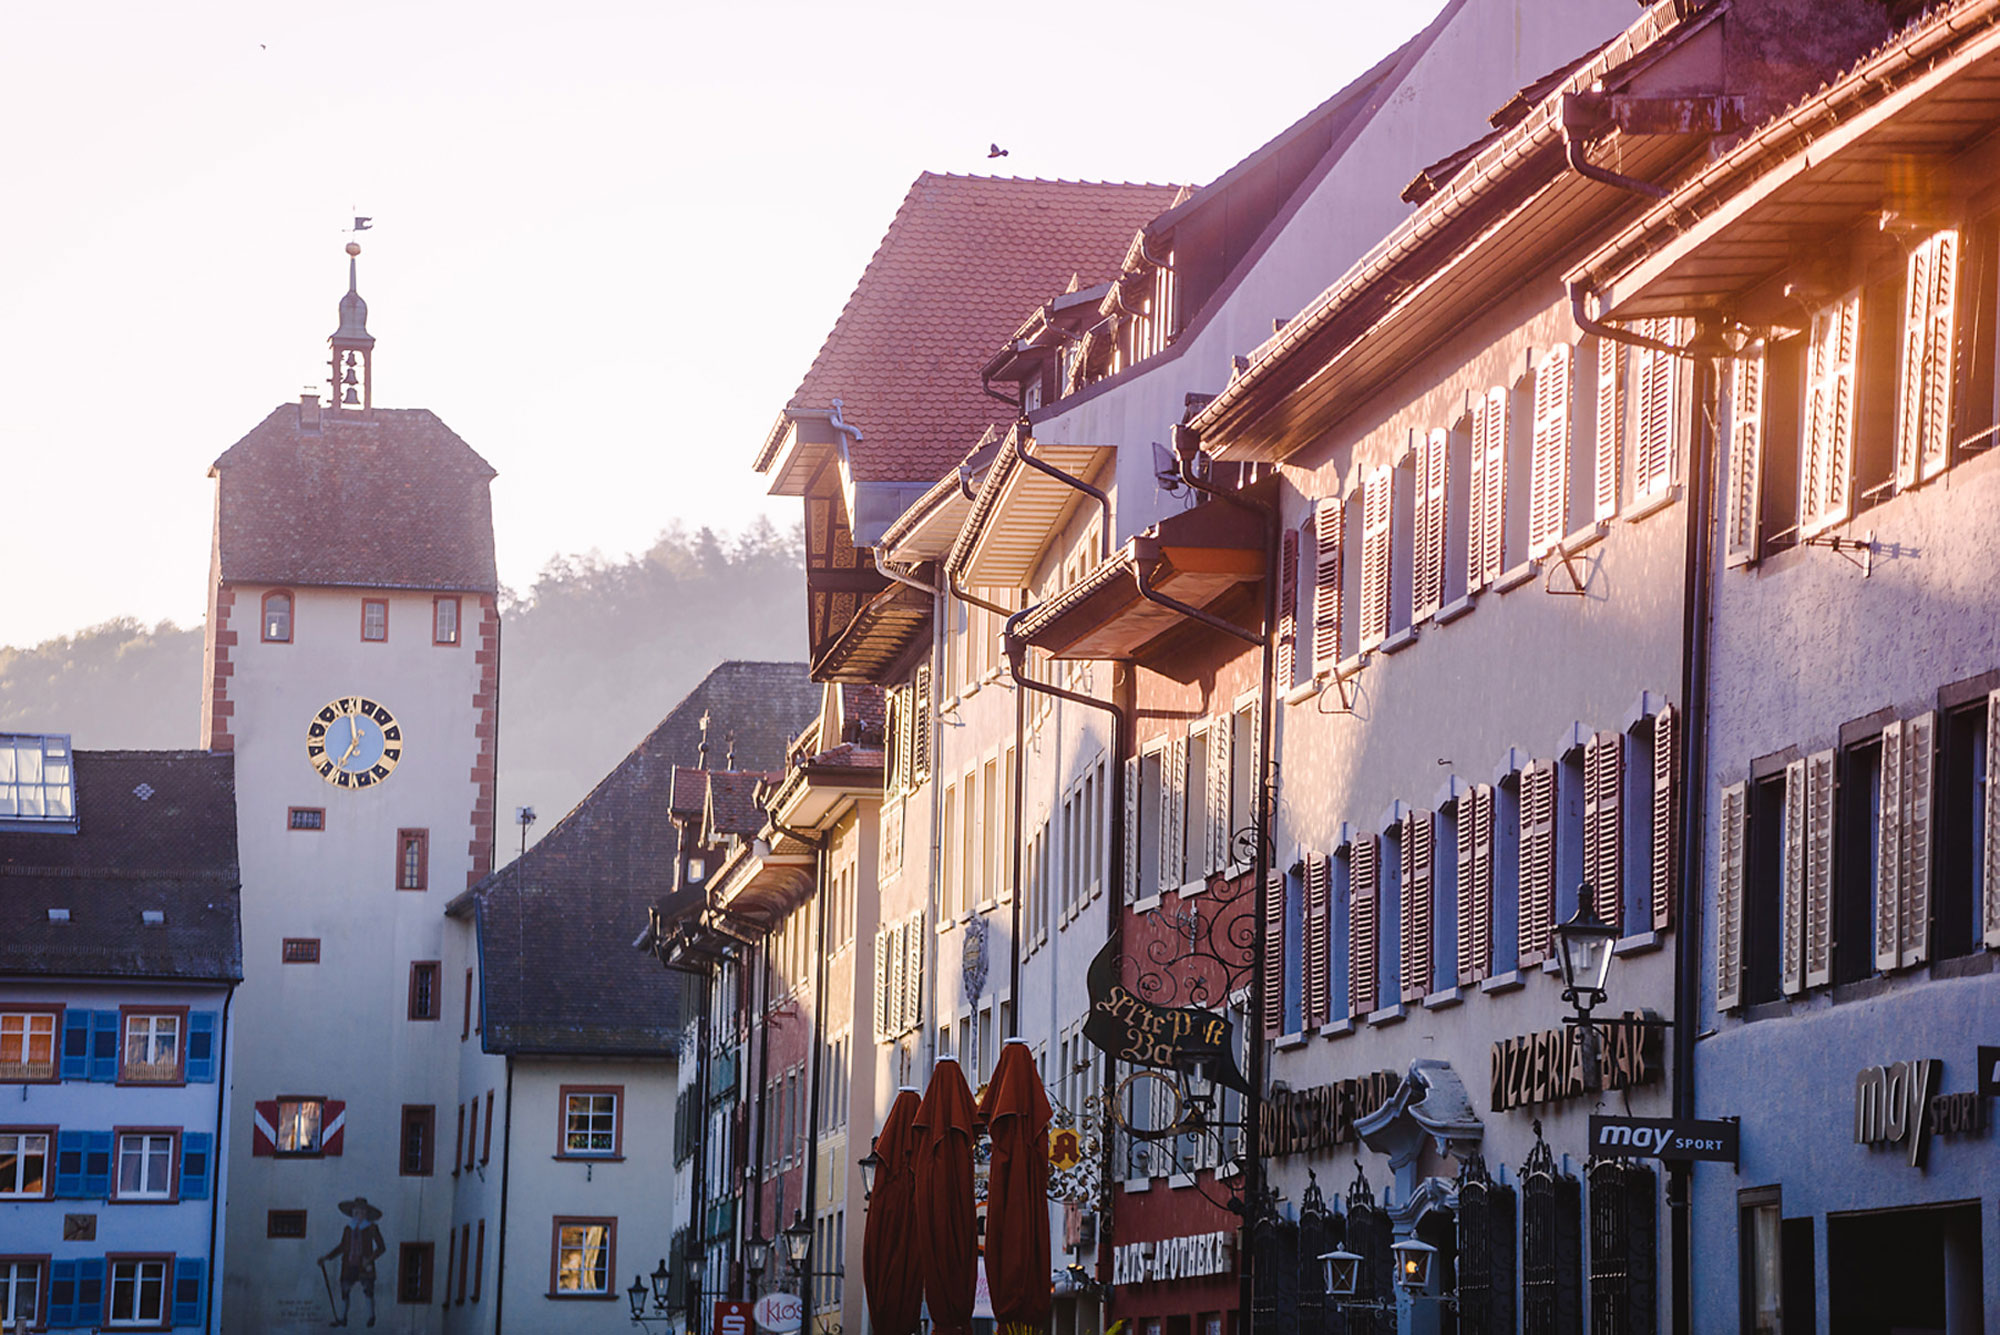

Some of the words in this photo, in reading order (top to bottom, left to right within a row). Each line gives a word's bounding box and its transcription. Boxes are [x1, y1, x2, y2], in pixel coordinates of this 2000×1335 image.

[1165, 1010, 1226, 1046] Pst
[1854, 1059, 1931, 1168] may
[1599, 1125, 1675, 1155] may
[1675, 1137, 1724, 1151] SPORT
